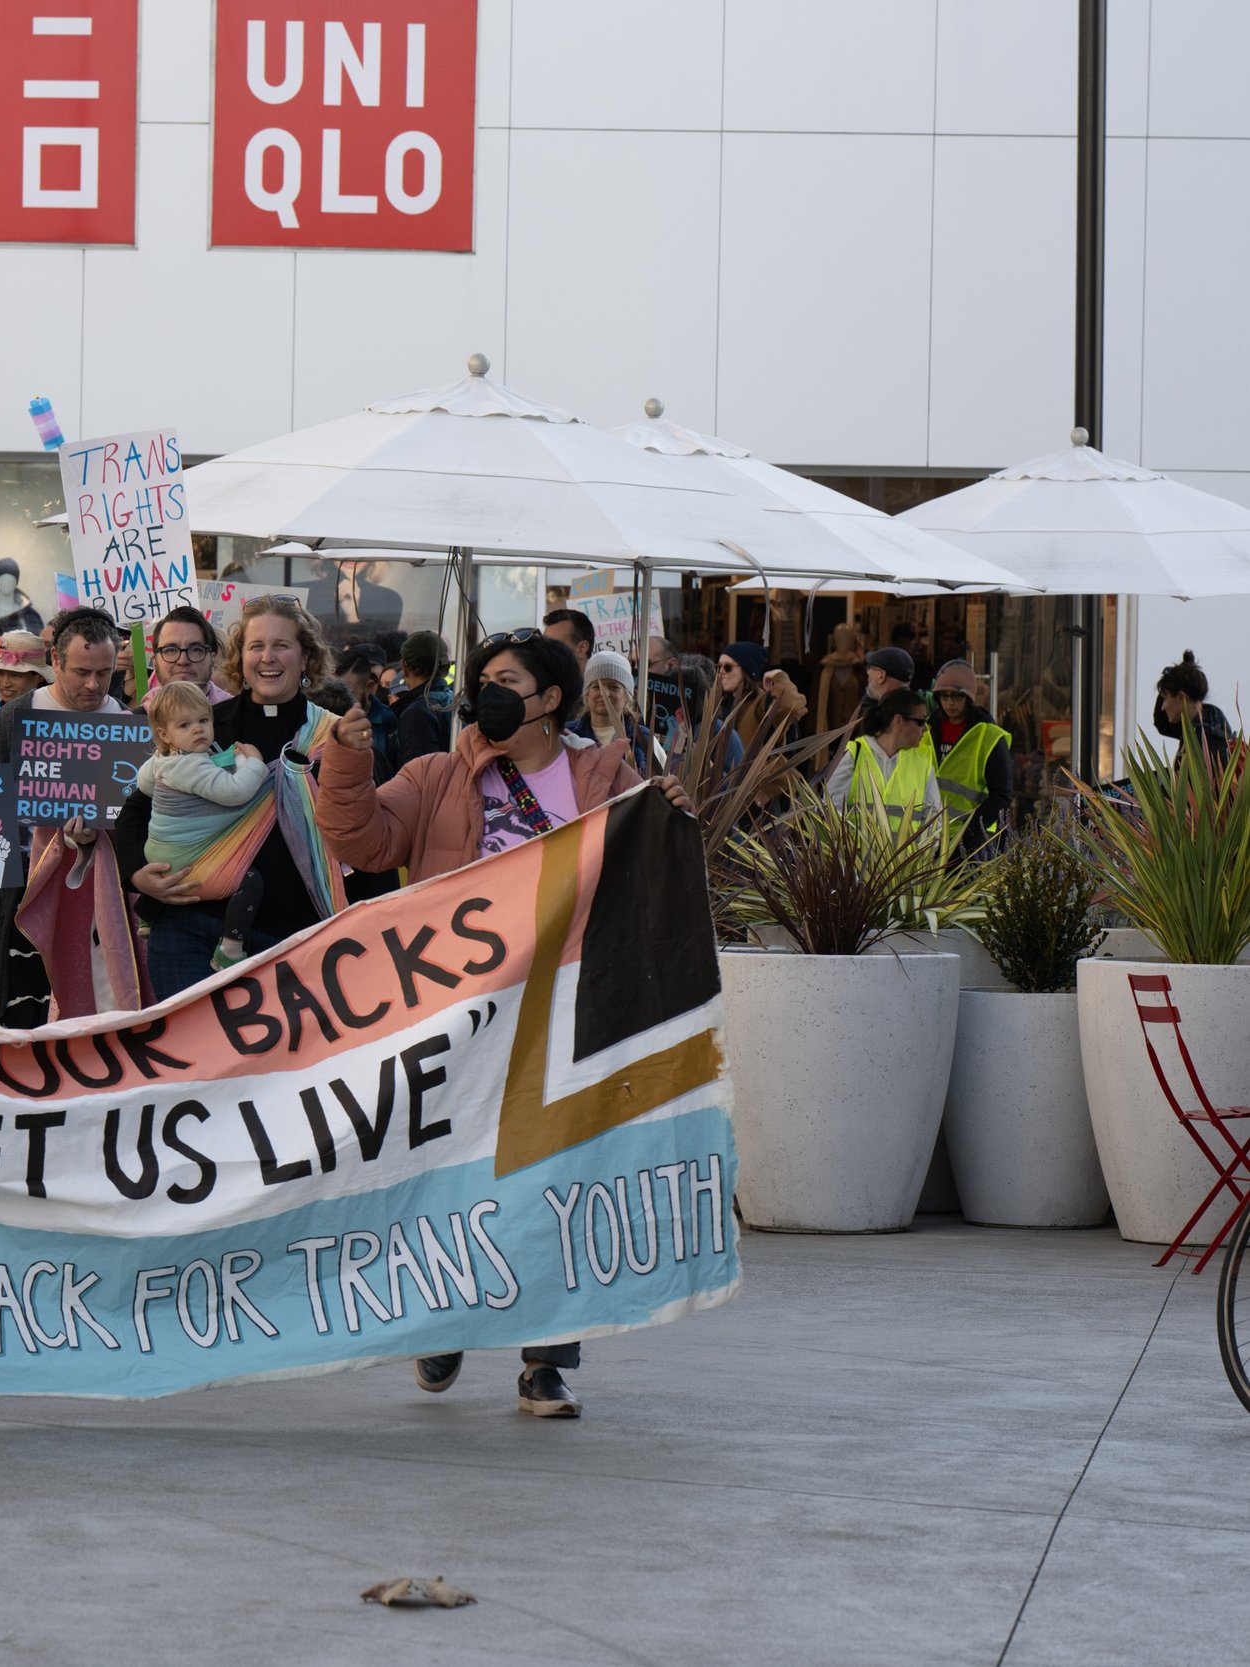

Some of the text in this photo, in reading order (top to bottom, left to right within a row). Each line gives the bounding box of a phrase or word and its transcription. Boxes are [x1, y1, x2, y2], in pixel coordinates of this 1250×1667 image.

[247, 20, 426, 107] UNI
[244, 127, 443, 228] QLO
[69, 434, 180, 485] TRANS
[79, 484, 184, 534] RIGHTS
[103, 525, 166, 563] ARE
[83, 555, 188, 597] HUMAN
[20, 740, 102, 760] RIGHTS
[22, 719, 153, 743] TRANSGEND
[18, 760, 62, 779] ARE
[18, 780, 96, 800] HUMAN
[17, 800, 98, 820] RIGHTS
[212, 897, 507, 1055] BACKS
[103, 1099, 217, 1204] US
[132, 1248, 280, 1354] FOR
[287, 1199, 520, 1334] TRANS
[543, 1153, 725, 1292] YOUTH
